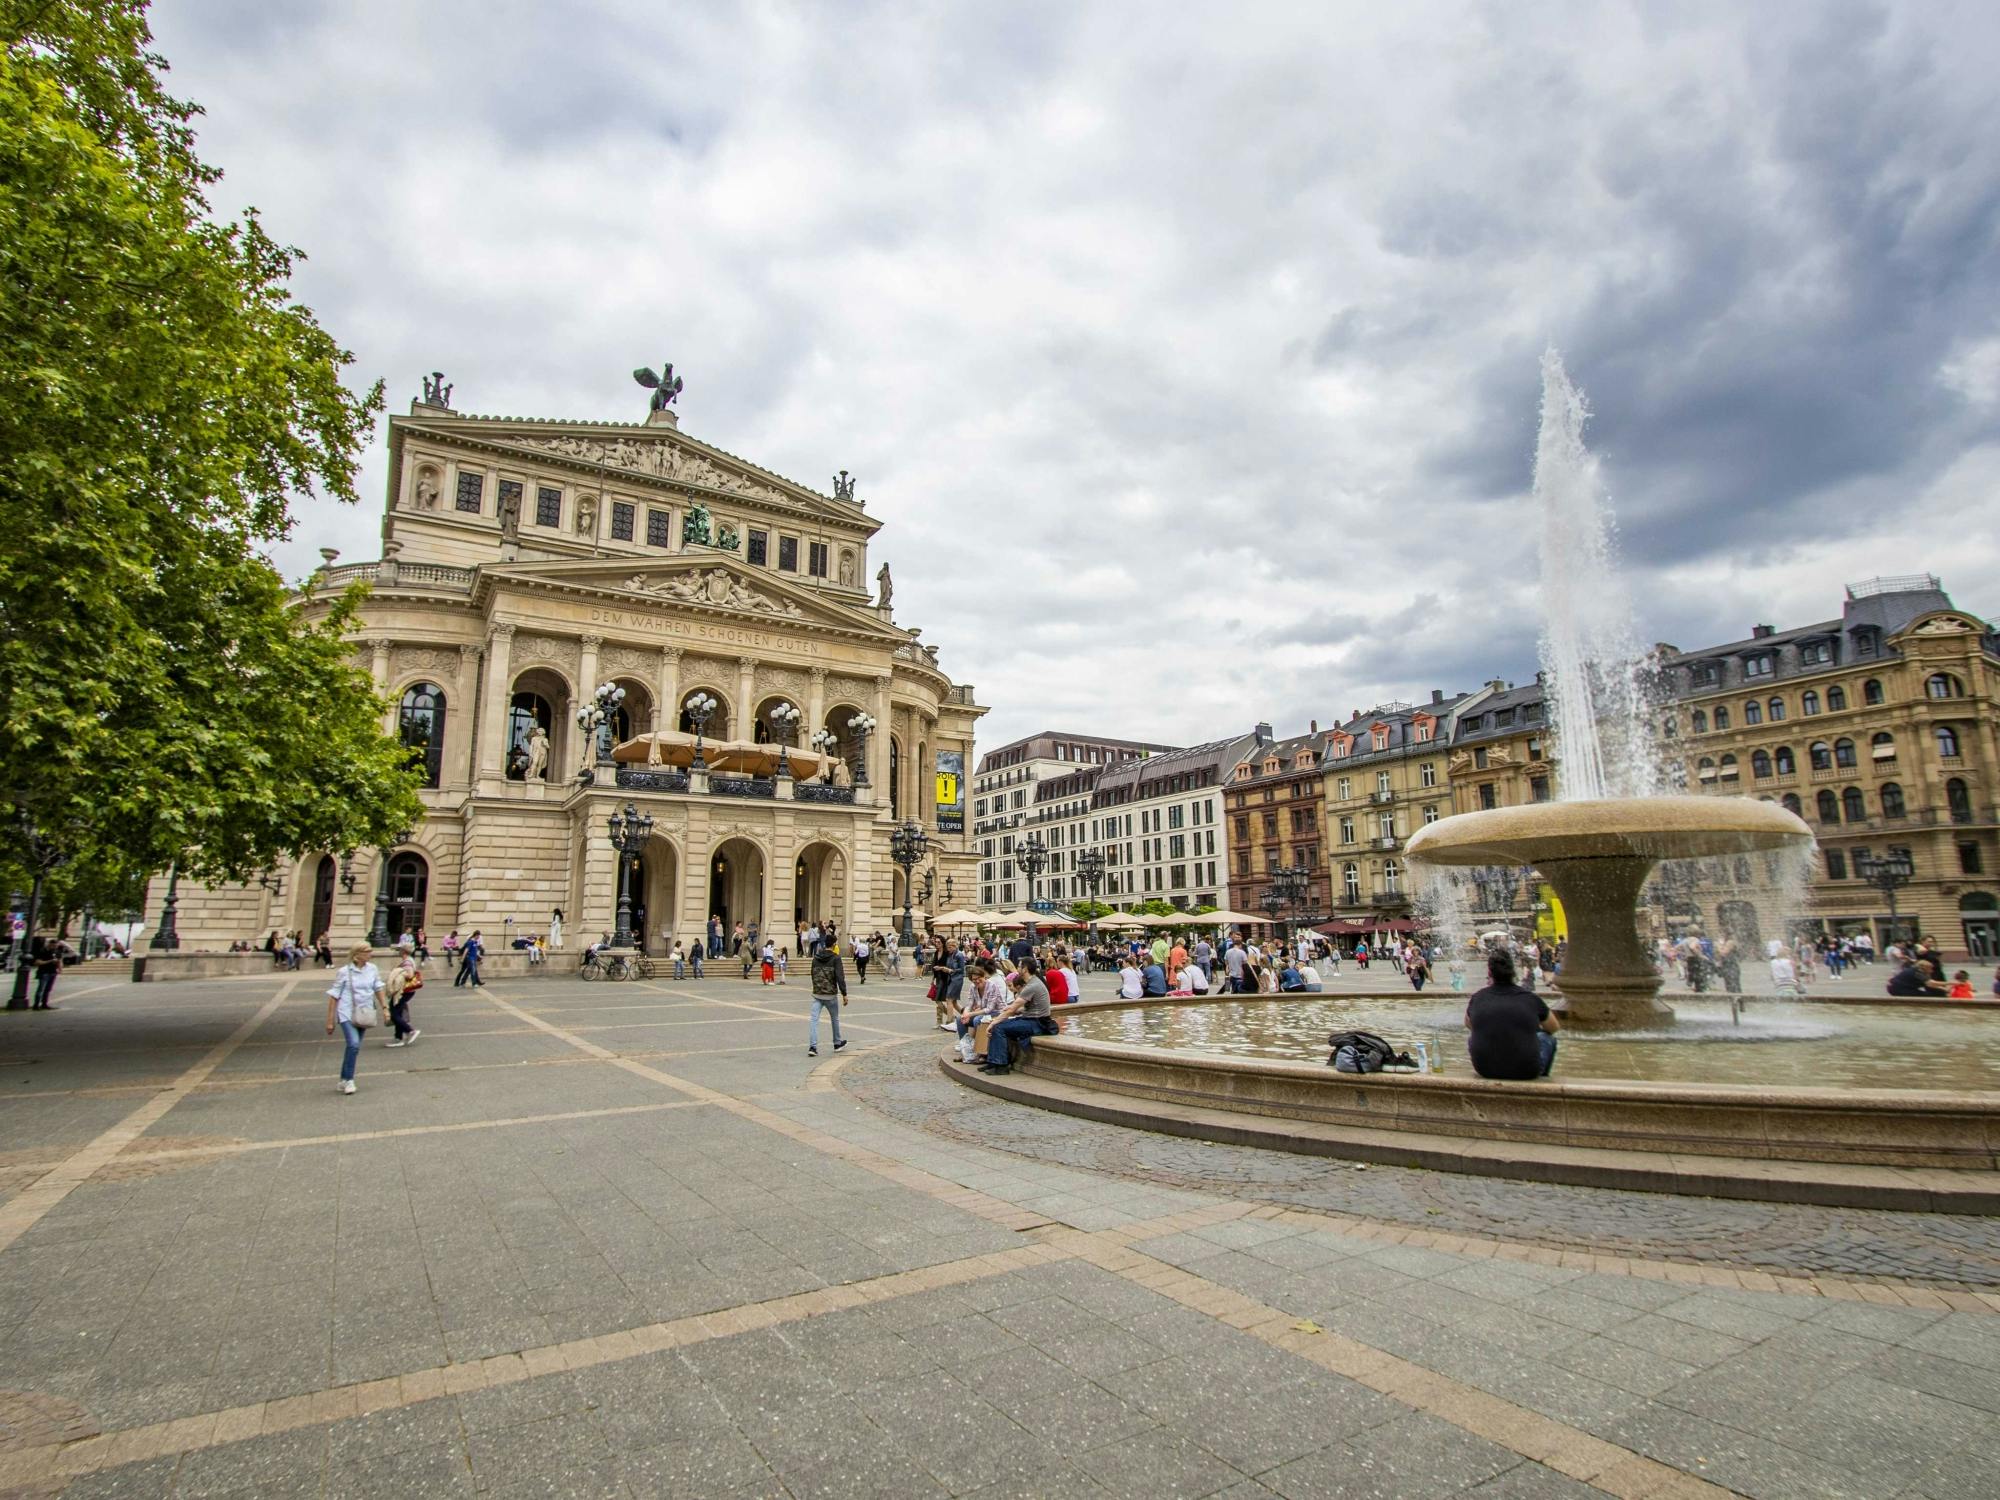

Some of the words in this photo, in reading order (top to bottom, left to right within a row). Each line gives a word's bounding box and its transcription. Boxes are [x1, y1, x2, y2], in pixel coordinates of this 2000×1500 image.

[591, 610, 622, 625] DEM
[630, 615, 691, 634] WAHREN
[699, 626, 769, 646] SCHOENEN
[776, 638, 818, 653] GUTEN
[946, 822, 962, 830] OPER
